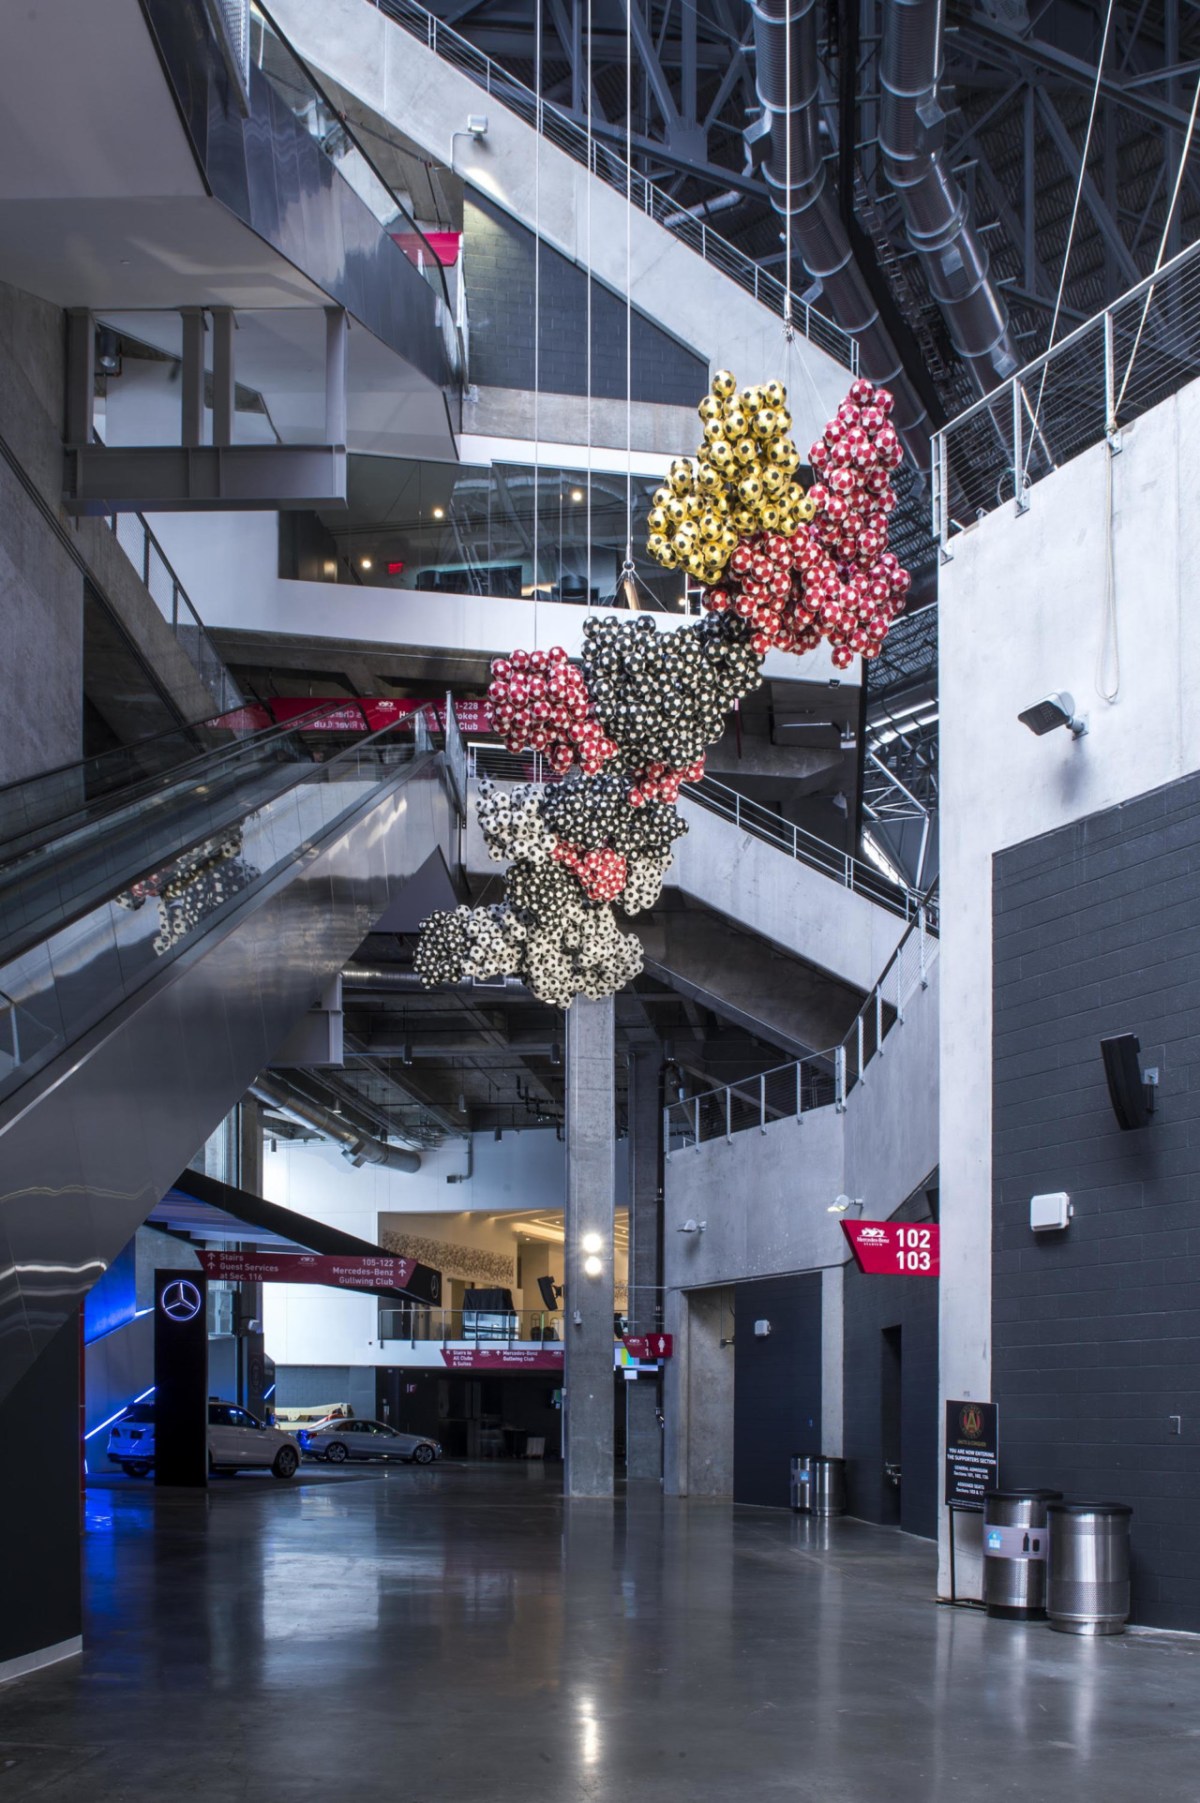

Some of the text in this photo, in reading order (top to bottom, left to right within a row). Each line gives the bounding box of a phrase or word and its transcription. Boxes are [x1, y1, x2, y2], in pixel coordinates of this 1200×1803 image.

[459, 722, 478, 730] Club
[896, 1228, 930, 1248] 102
[896, 1250, 930, 1270] 103
[220, 1262, 279, 1272] Guest Services
[332, 1266, 394, 1276] Mercedes-Benz
[339, 1276, 374, 1286] Gullwing
